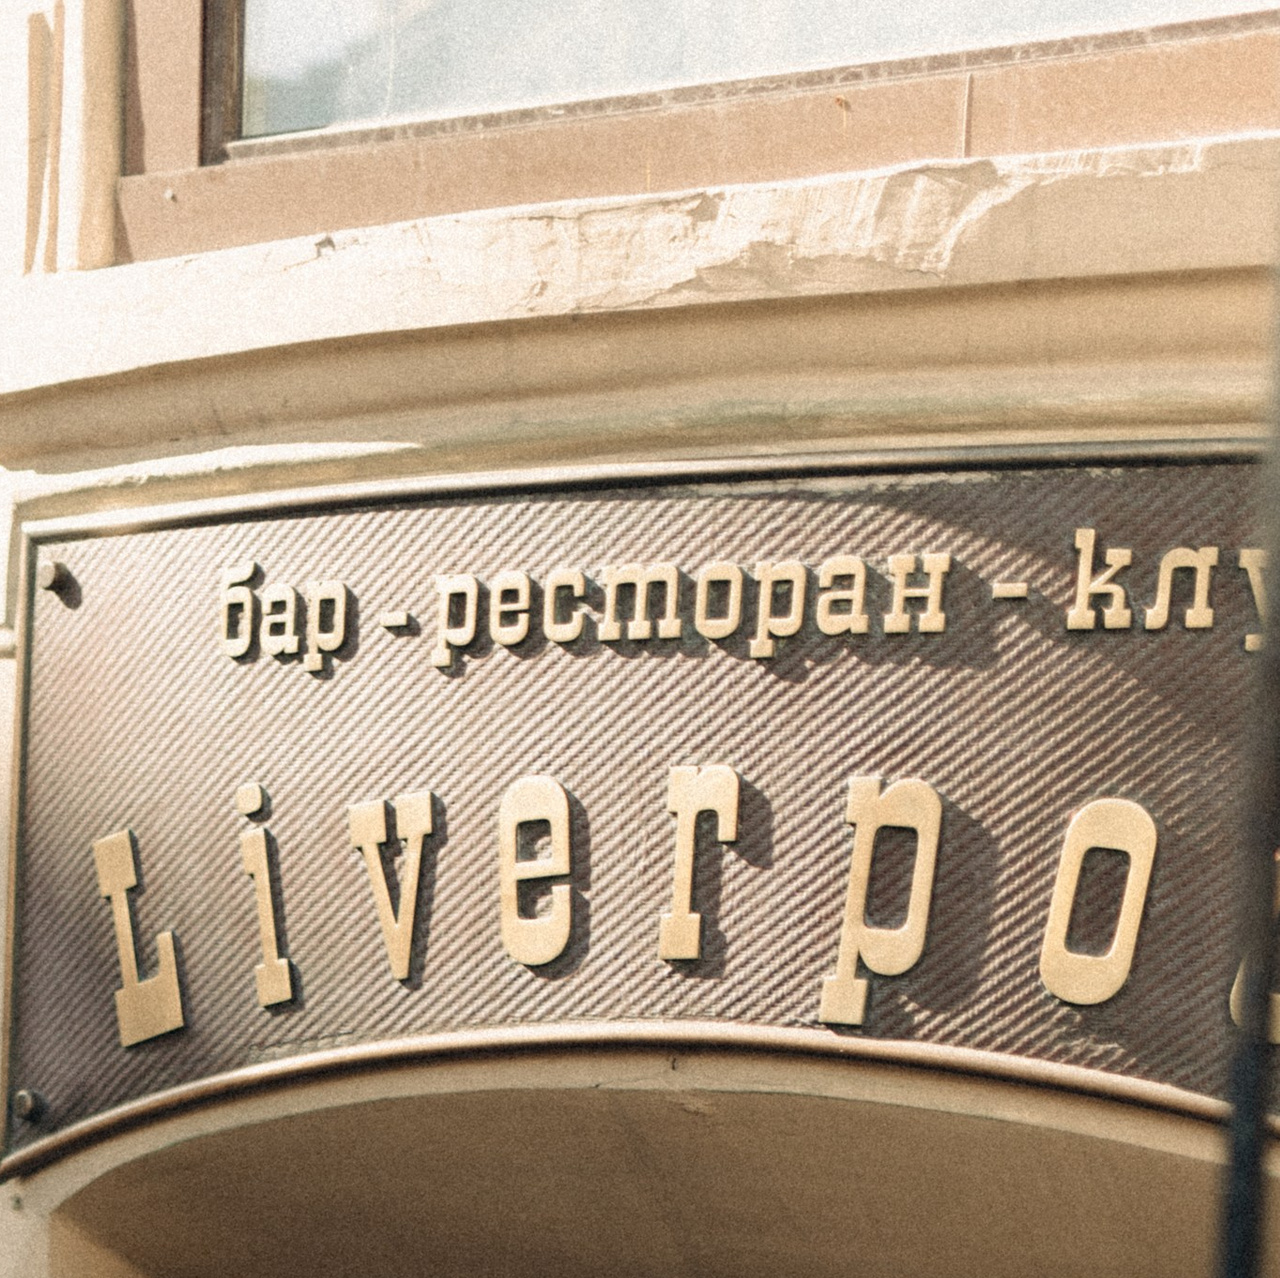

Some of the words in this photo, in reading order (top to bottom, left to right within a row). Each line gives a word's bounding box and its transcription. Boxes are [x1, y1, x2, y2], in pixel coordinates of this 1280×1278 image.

[221, 561, 347, 672] бар
[431, 553, 951, 668] ресторан
[92, 763, 1280, 1049] Liverpo
